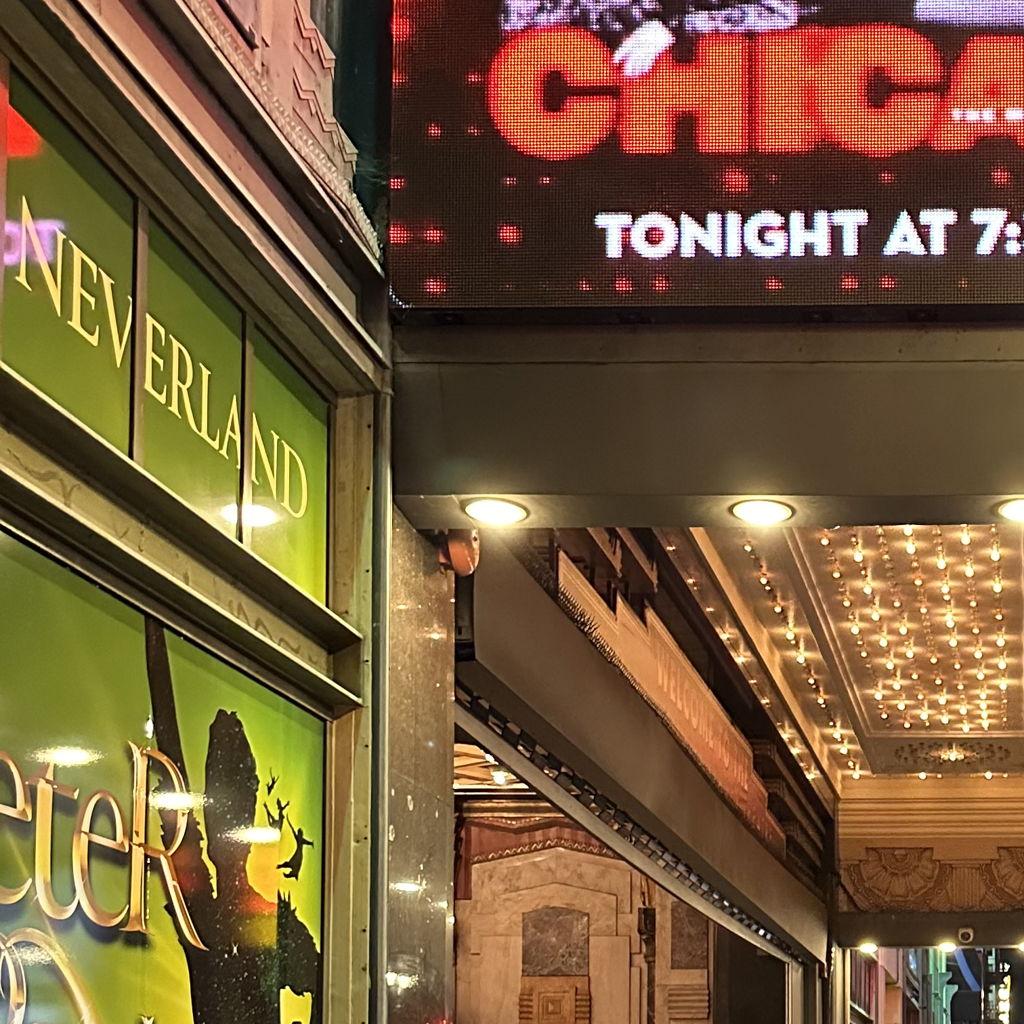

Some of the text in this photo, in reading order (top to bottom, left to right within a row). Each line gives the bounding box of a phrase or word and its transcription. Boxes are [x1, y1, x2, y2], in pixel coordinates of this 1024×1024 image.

[951, 107, 997, 123] THE
[594, 210, 869, 259] TONIGHT
[883, 208, 957, 257] AT
[15, 195, 309, 519] NEVERLAND
